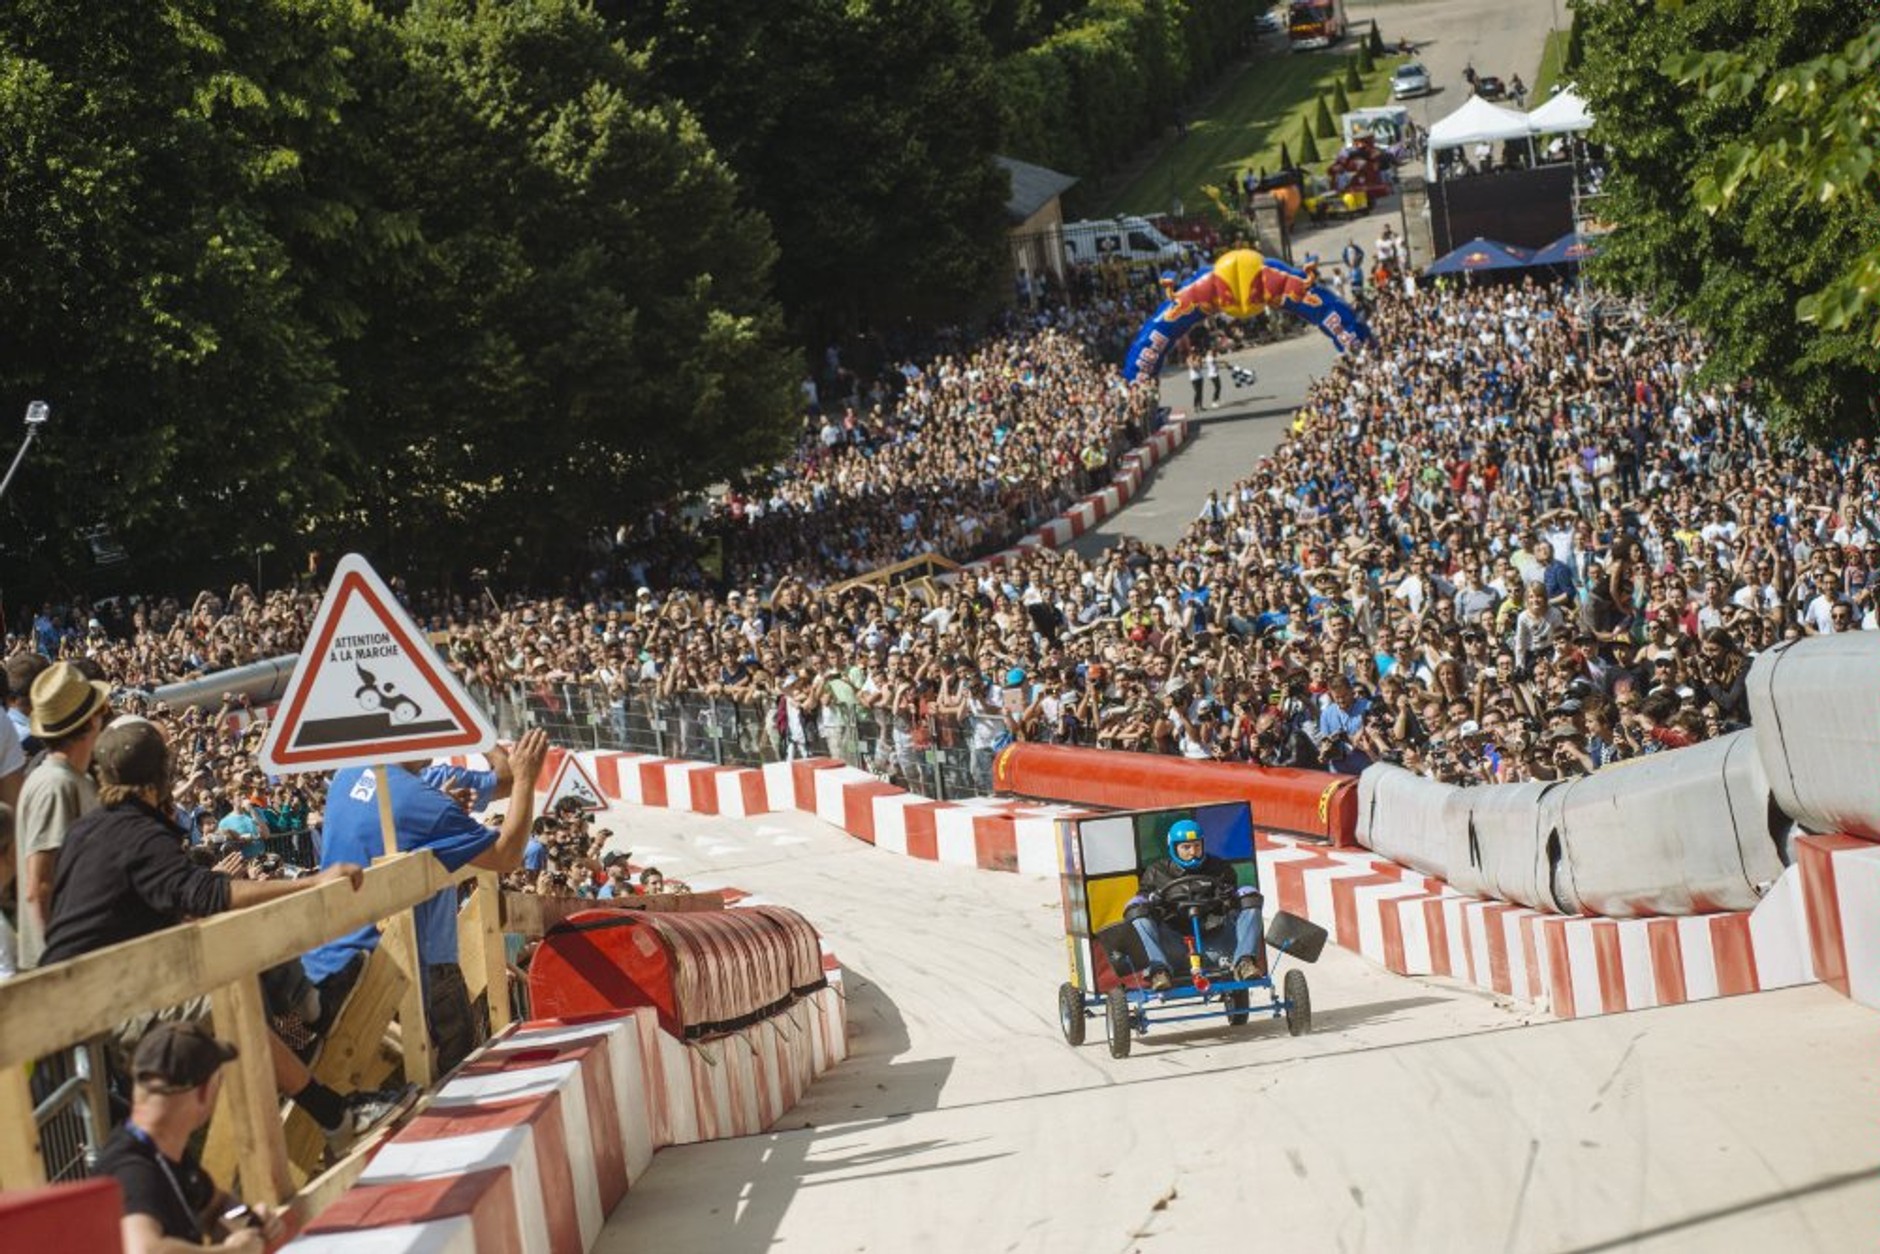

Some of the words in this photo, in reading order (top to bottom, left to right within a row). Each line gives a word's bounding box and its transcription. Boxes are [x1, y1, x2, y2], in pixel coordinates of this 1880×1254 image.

[335, 633, 390, 648] ATTENTION
[340, 650, 352, 661] LA
[355, 645, 398, 659] MARCHE
